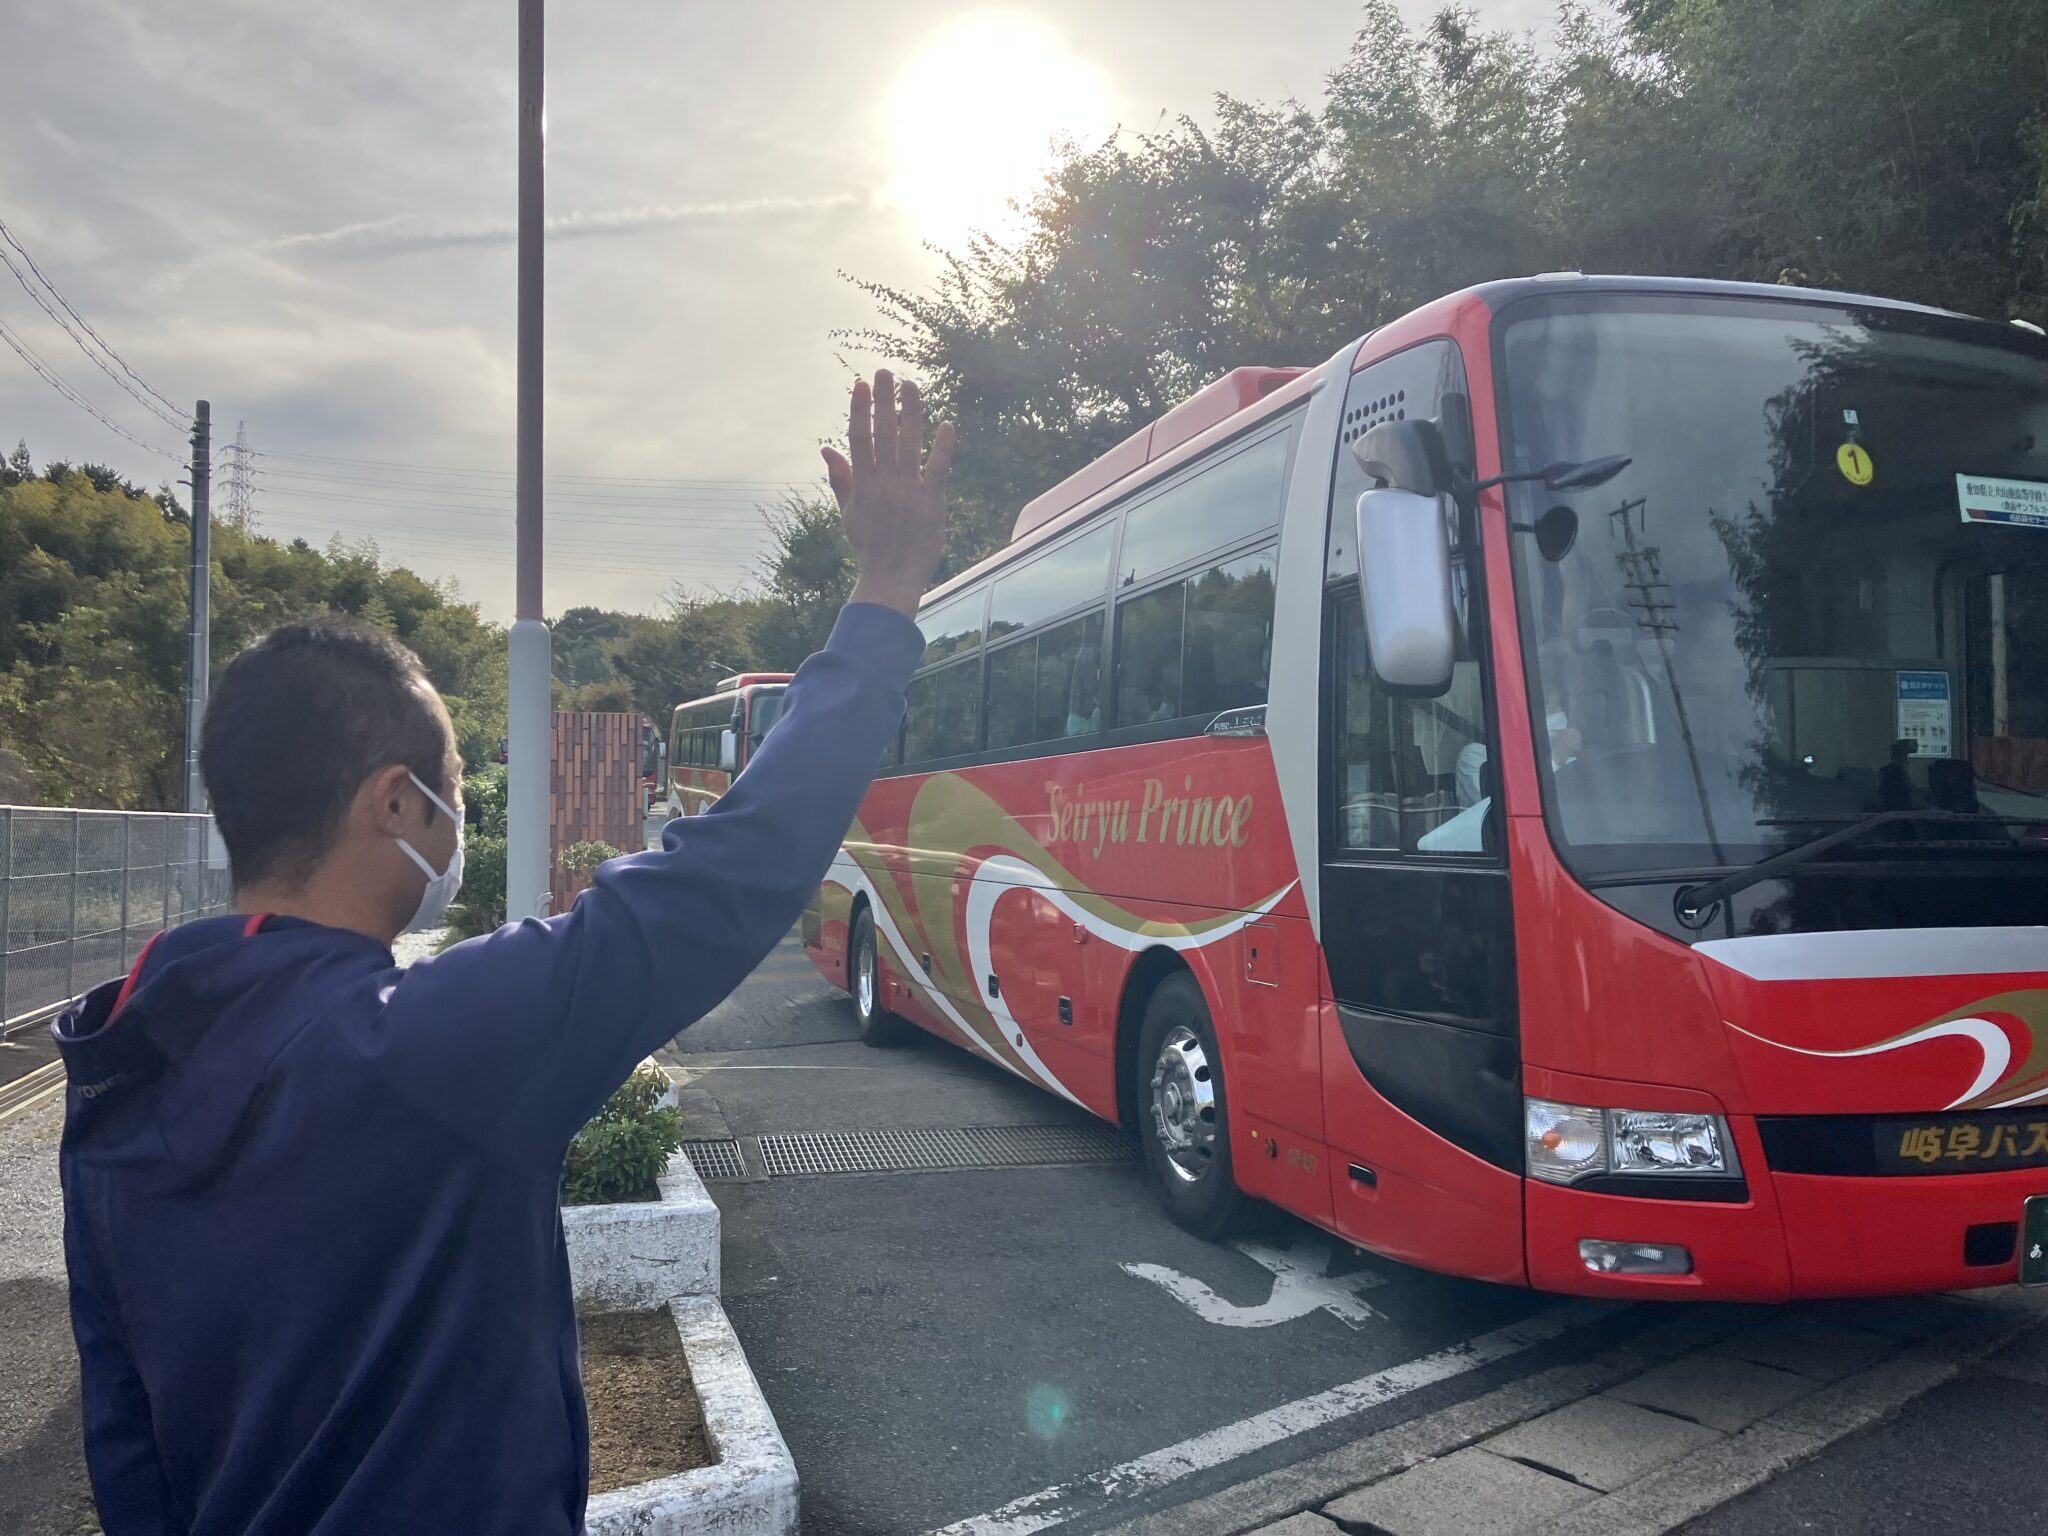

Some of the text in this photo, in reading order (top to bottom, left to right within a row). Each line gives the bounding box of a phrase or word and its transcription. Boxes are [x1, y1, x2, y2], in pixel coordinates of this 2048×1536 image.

[1848, 449, 1860, 475] 1
[1047, 774, 1255, 859] Seiryu Prince
[1899, 1122, 2048, 1163] 岐阜バス
